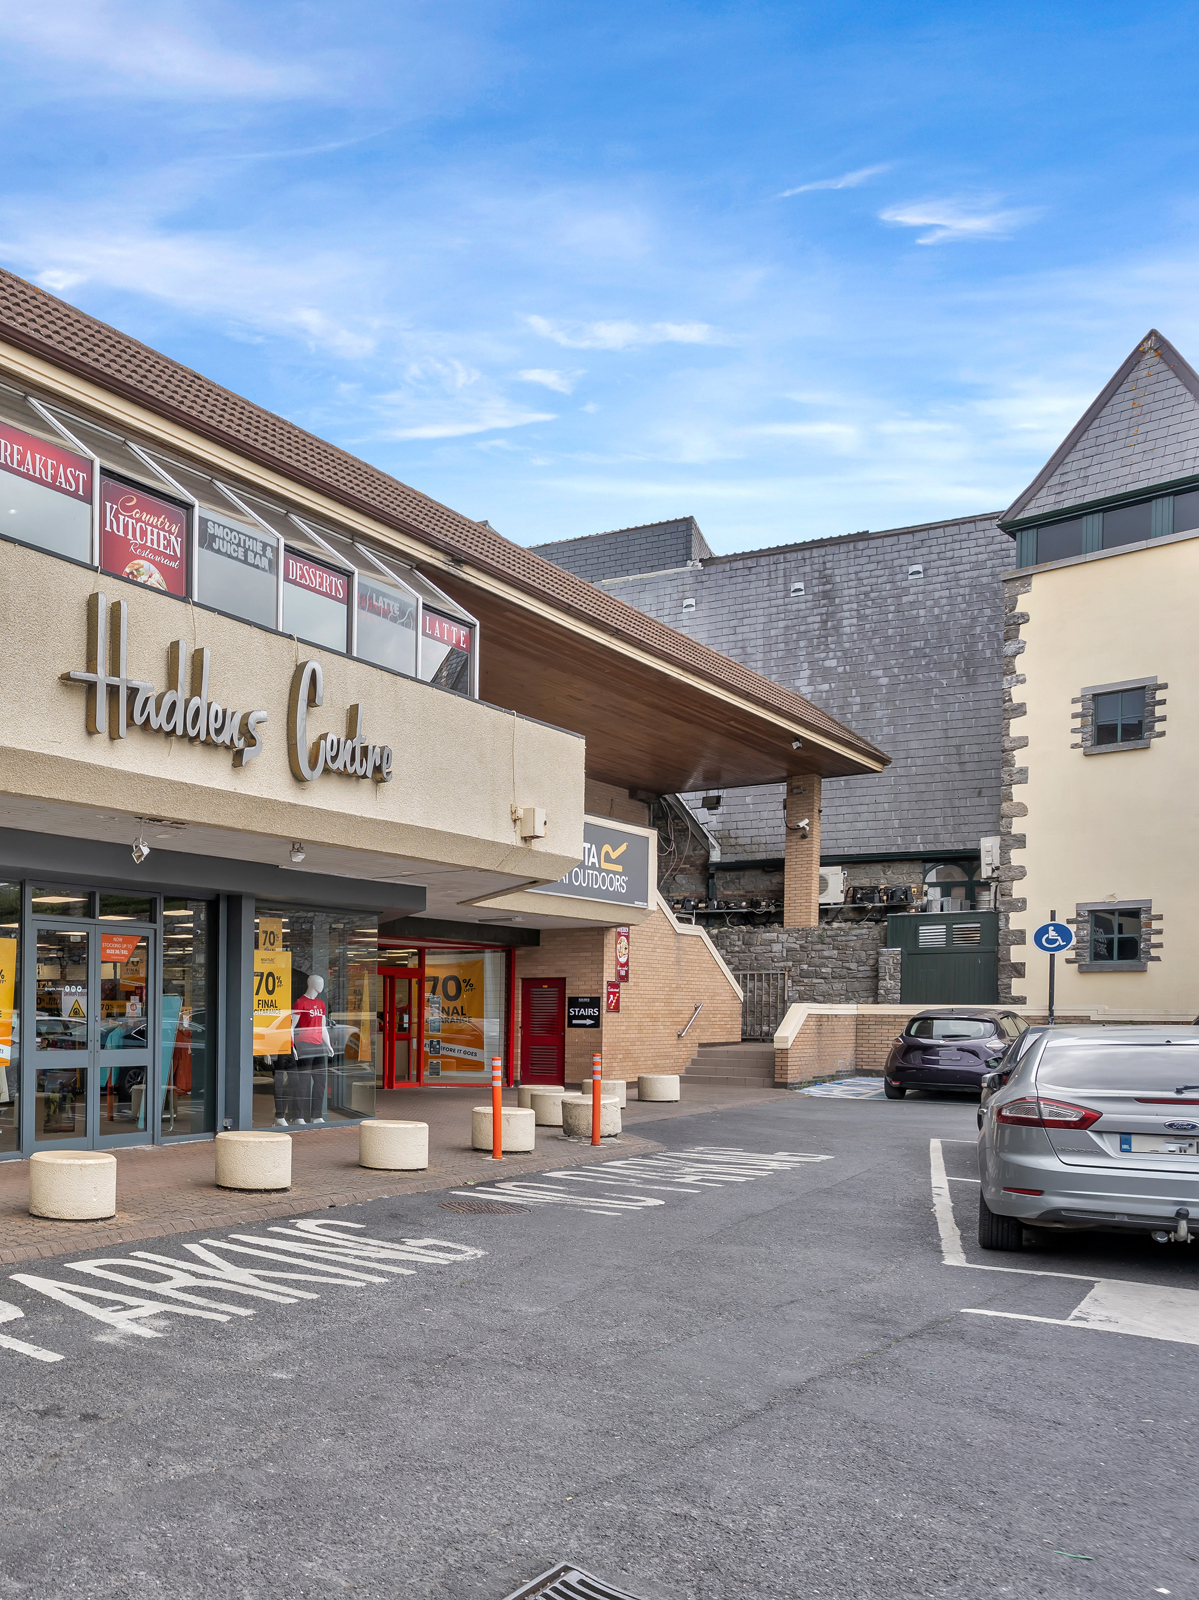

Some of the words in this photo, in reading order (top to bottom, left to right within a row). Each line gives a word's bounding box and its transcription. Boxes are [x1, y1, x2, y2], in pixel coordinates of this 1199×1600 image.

[105, 501, 181, 558] KITCHEN
[118, 495, 181, 536] Country
[129, 540, 179, 569] Restaurant
[207, 521, 263, 551] SMOOTHIE
[266, 546, 273, 559] &
[212, 538, 244, 561] JUICE
[247, 551, 269, 570] BAR
[288, 559, 344, 599] DESSERTS
[373, 593, 399, 615] LATTE
[425, 616, 466, 649] LATTE
[59, 591, 268, 768] Haddens
[287, 660, 393, 783] Centre
[258, 1000, 277, 1008] FINAL
[569, 1008, 599, 1016] STAIRS
